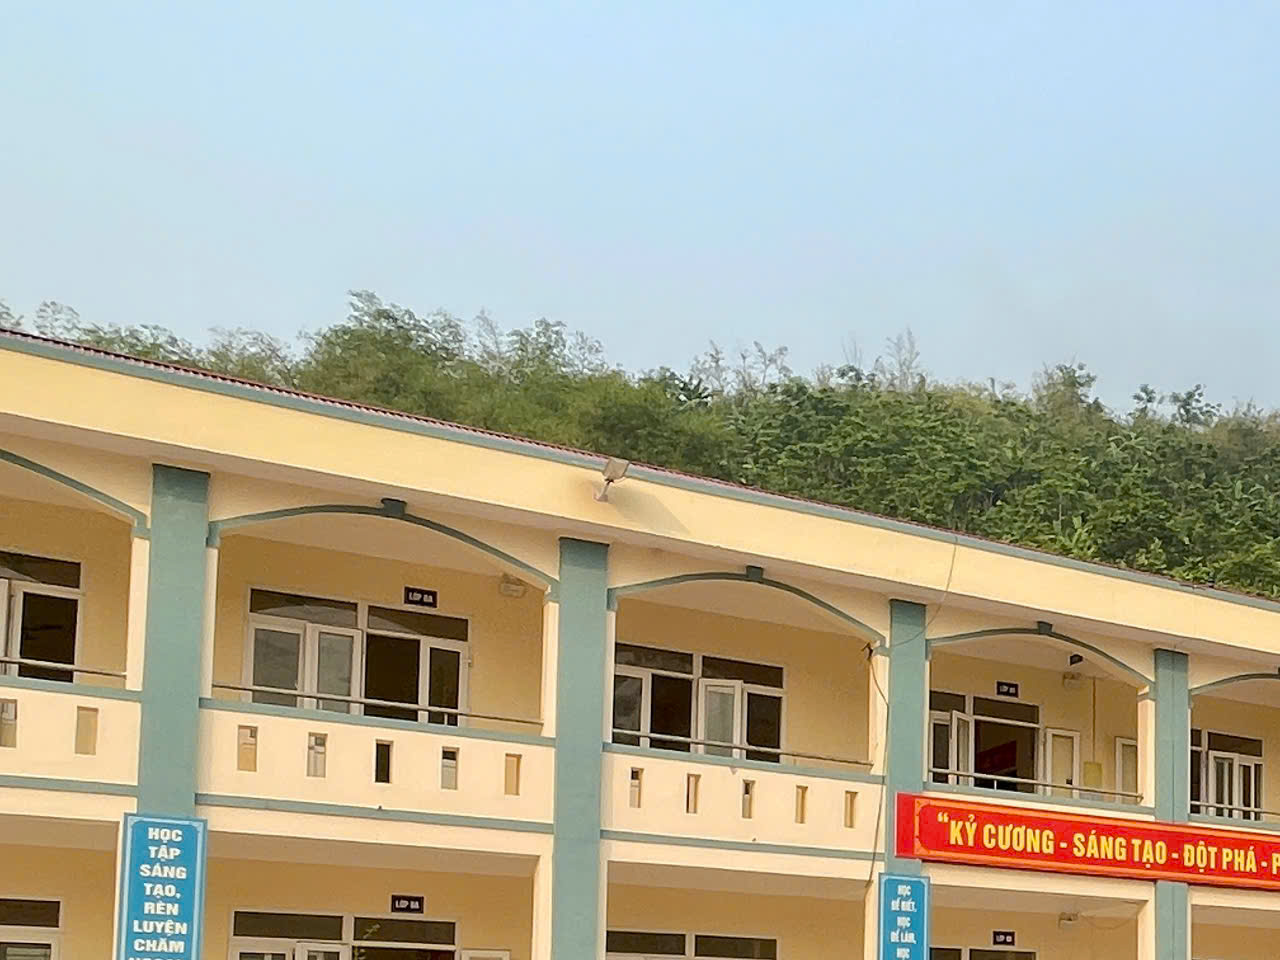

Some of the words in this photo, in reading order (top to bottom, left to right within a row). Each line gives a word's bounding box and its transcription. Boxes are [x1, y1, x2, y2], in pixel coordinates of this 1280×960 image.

[148, 827, 183, 843] HỌC
[149, 846, 181, 862] TẬP
[983, 824, 1054, 854] CƯƠNG
[1073, 830, 1126, 861] SÁNG
[1131, 838, 1167, 868] TẠO
[1183, 841, 1217, 872] ĐỘT
[1221, 846, 1257, 873] PHÁ
[140, 863, 187, 879] SÁNG
[144, 883, 181, 899] TẠO,
[144, 900, 178, 916] RÈN
[133, 919, 187, 937] LUYỆN
[134, 938, 184, 953] CHĂM
